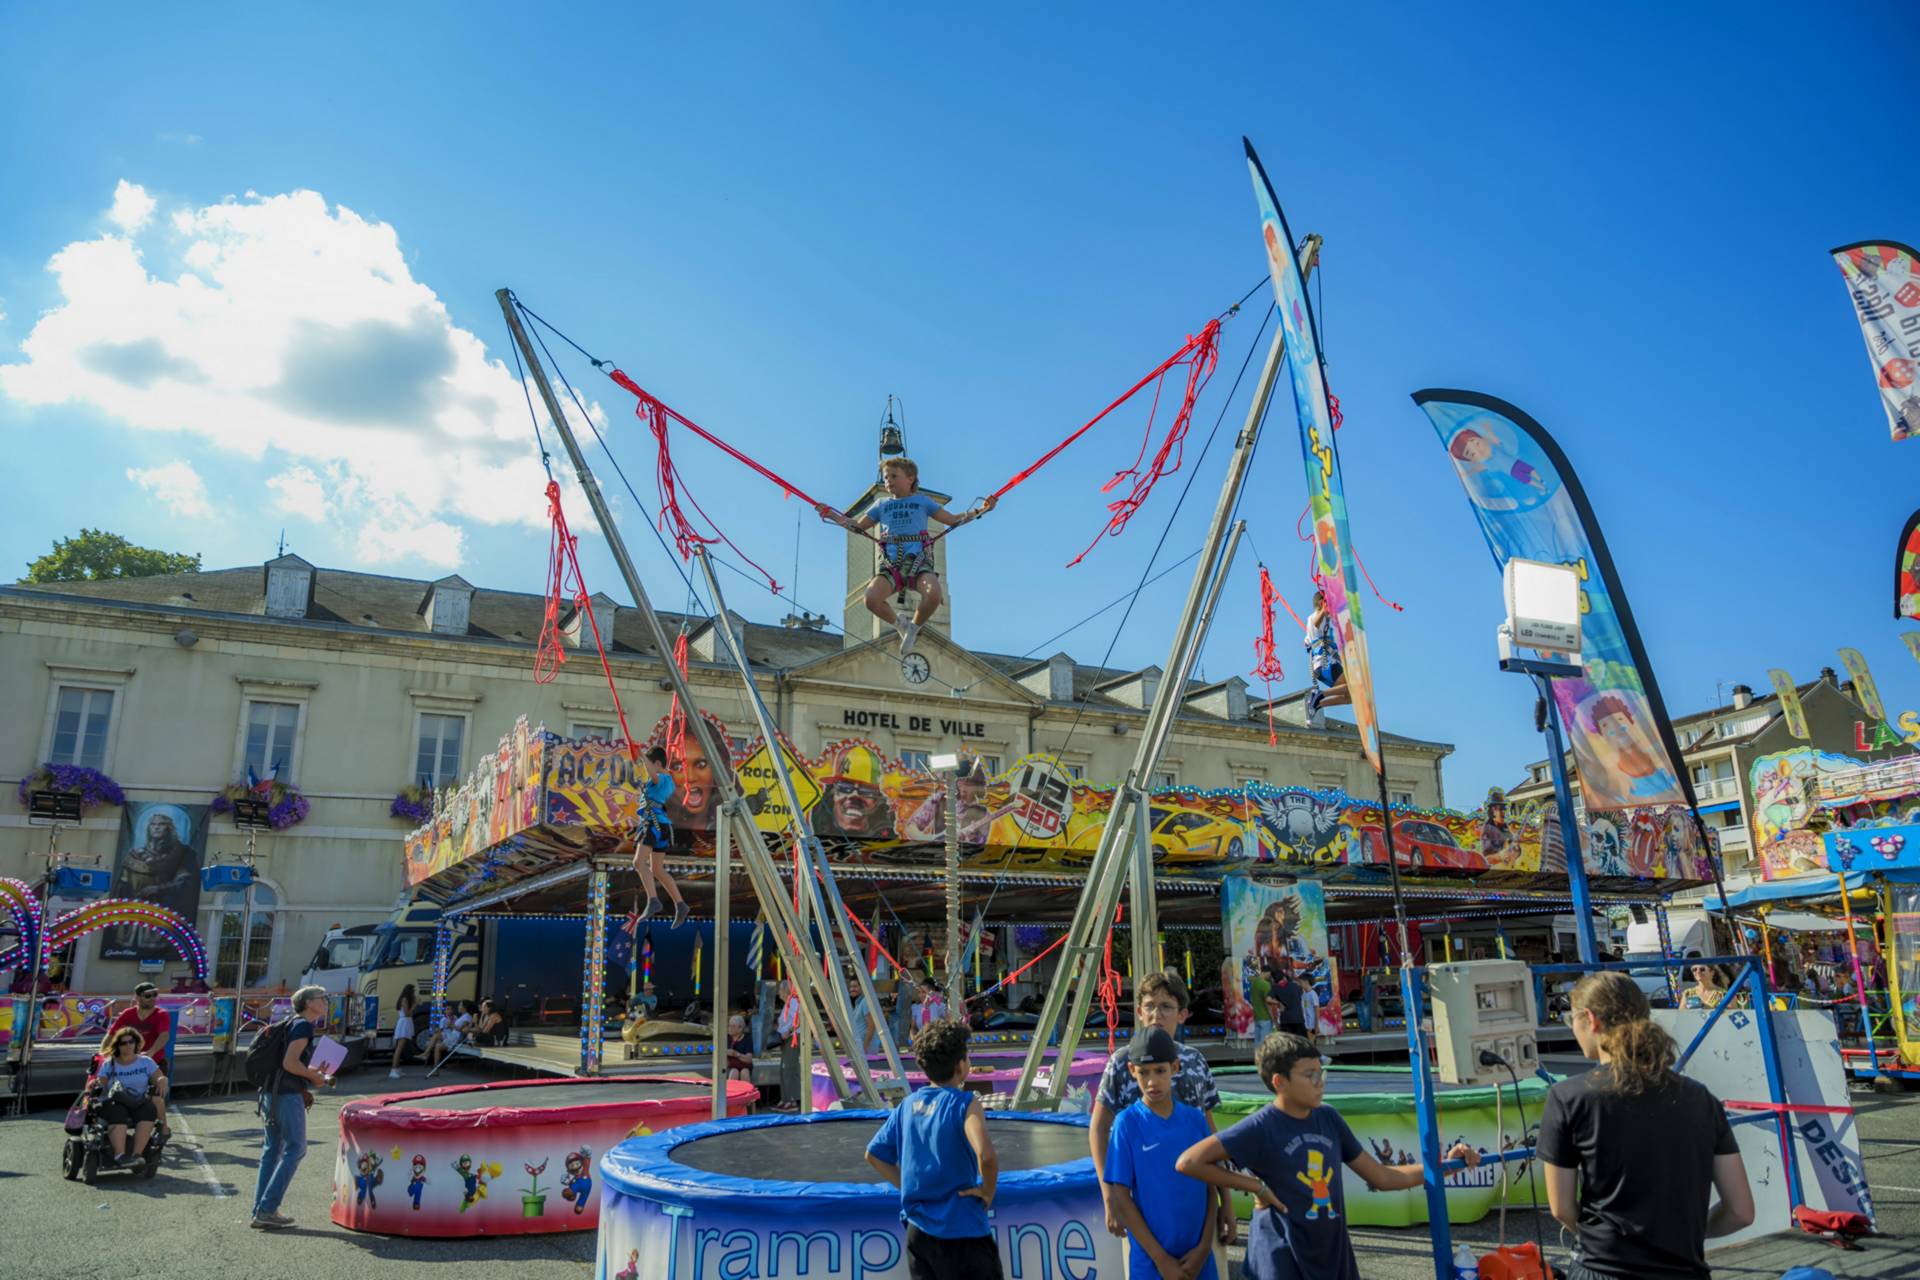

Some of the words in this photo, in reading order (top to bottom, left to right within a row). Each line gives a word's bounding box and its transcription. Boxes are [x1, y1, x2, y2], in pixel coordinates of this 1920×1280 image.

[892, 511, 910, 519] USA
[843, 709, 900, 730] HOTEL
[908, 716, 932, 733] DE
[940, 719, 985, 738] VILLE
[1290, 796, 1307, 805] THE
[763, 804, 792, 815] ZON
[661, 1206, 1097, 1280] Trampne
